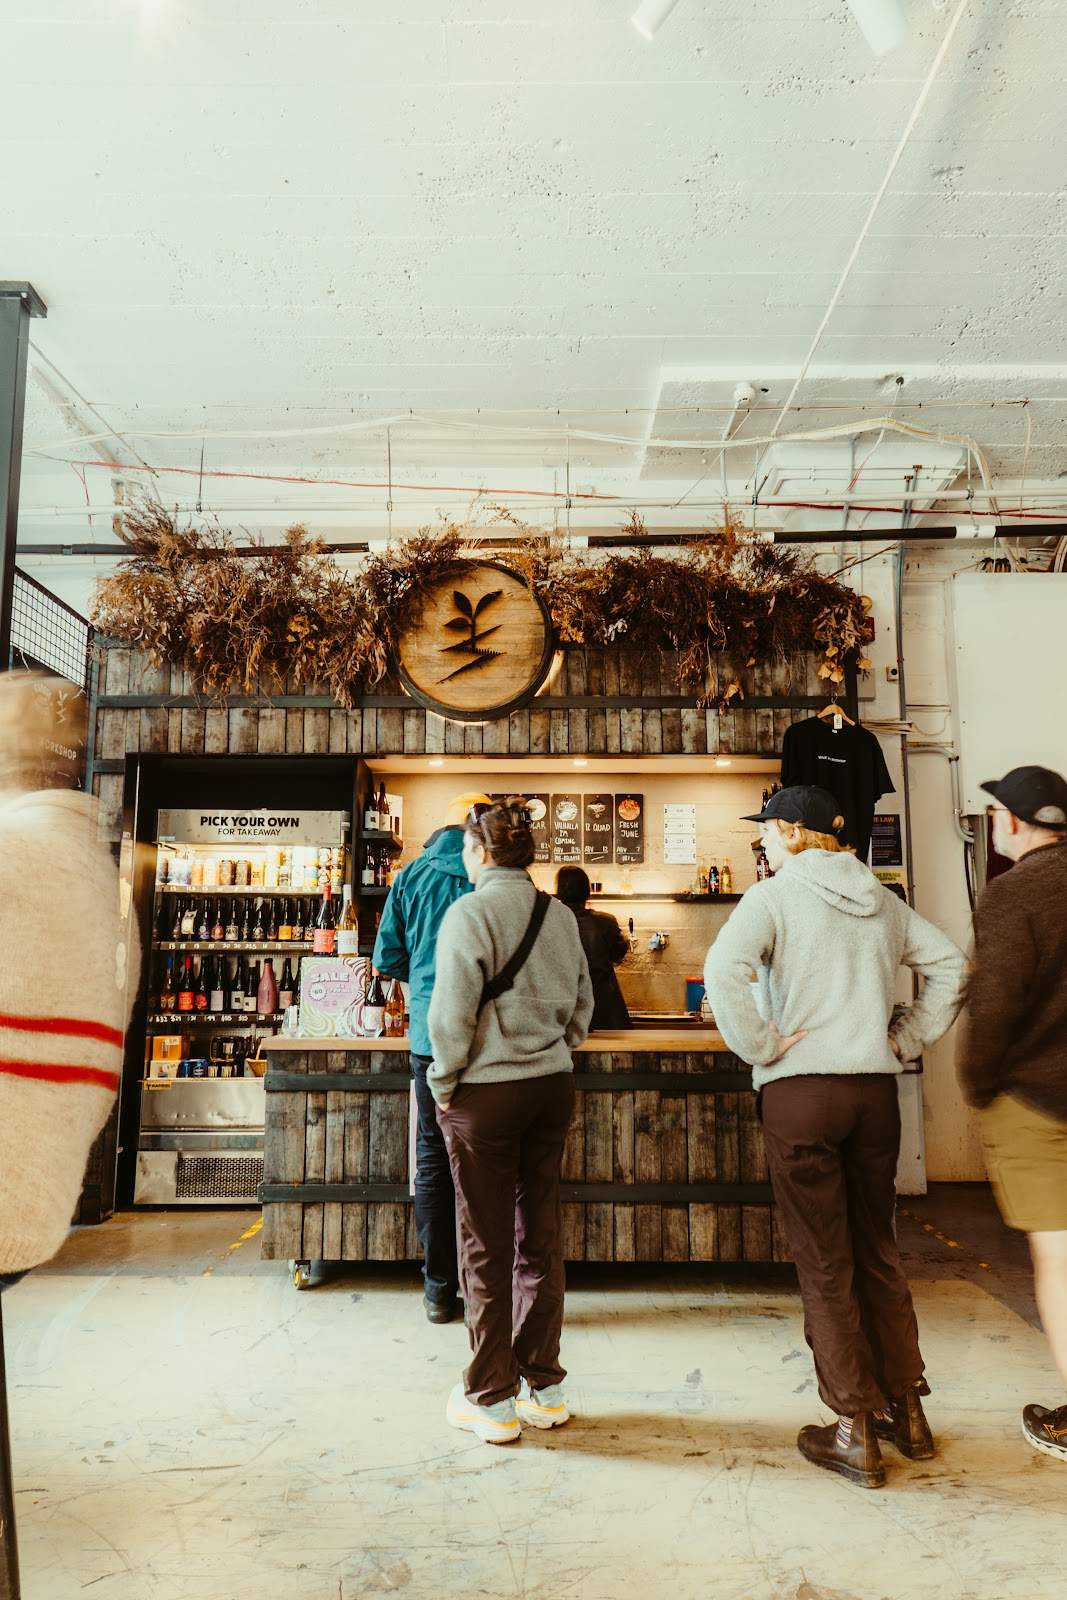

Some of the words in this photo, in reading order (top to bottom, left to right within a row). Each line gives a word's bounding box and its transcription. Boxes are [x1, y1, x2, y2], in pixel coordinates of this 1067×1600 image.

[41, 739, 77, 761] ORKSHOP
[200, 816, 228, 826] PICK
[231, 816, 265, 827] YOUR
[267, 817, 300, 827] OWN
[619, 821, 639, 829] FRESH
[593, 823, 611, 832] QUAD
[237, 828, 281, 836] TAKEAWAY
[621, 830, 639, 838] JUNE
[554, 837, 576, 845] COMING
